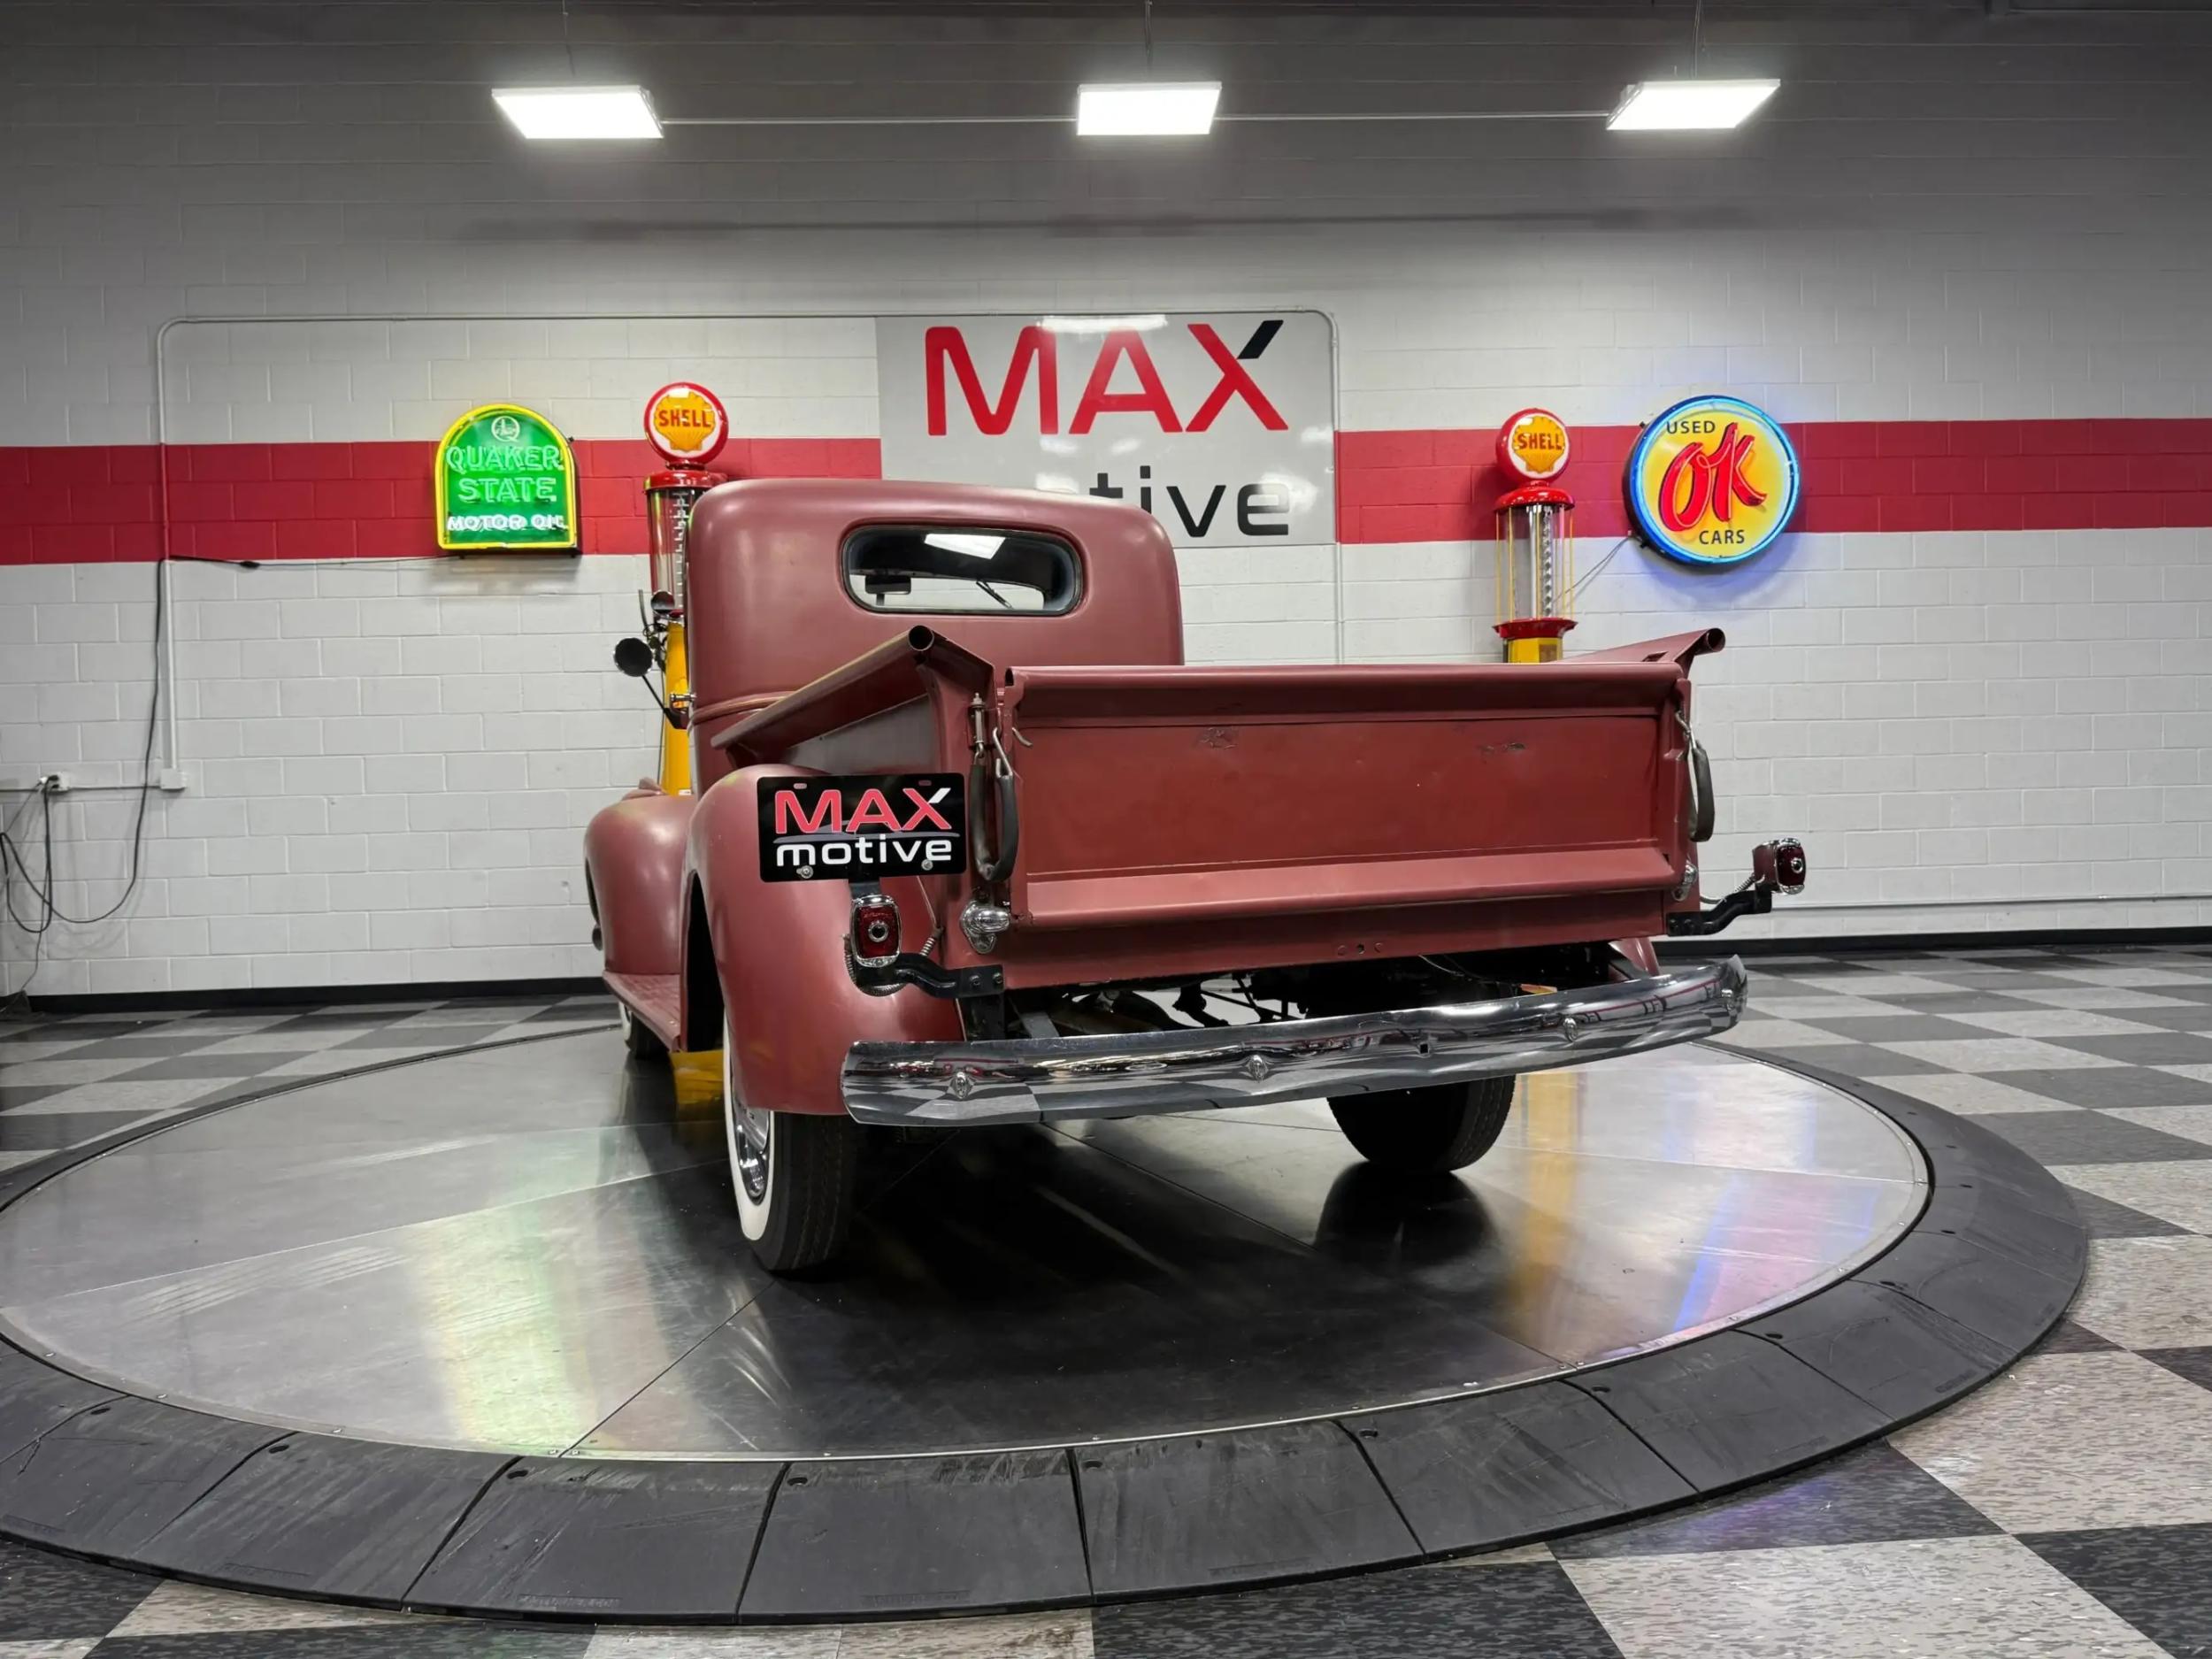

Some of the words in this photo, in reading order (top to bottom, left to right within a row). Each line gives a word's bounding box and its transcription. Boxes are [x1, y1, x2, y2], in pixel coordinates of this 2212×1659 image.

[925, 319, 1288, 435] MAX
[658, 409, 712, 429] SHELL
[1666, 420, 1716, 434] USED
[1517, 433, 1563, 450] SHELL
[446, 445, 565, 474] QUAKER
[458, 477, 557, 503] STATE
[1659, 422, 1767, 532] OK
[1089, 465, 1289, 537] tive
[447, 514, 528, 531] MOTOR
[532, 514, 568, 531] OIL
[1699, 529, 1745, 545] CARS
[775, 787, 952, 833] MAX
[777, 834, 952, 866] motive
